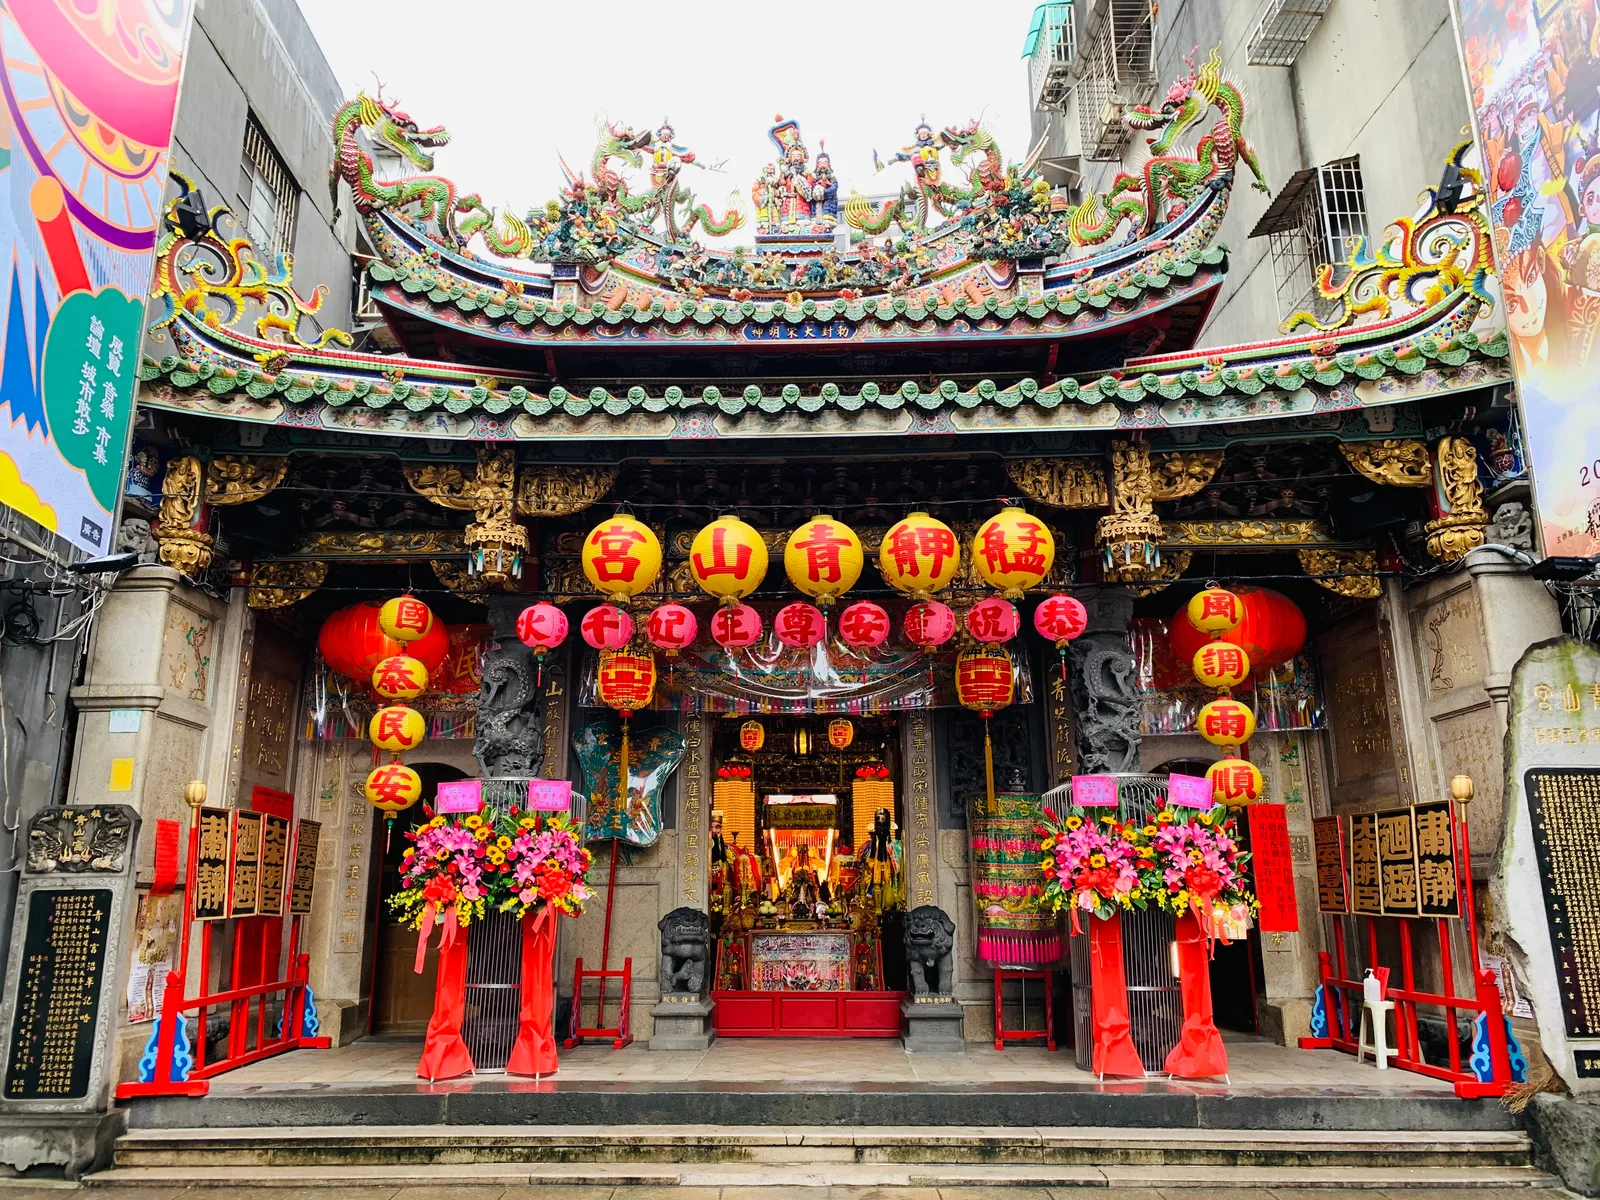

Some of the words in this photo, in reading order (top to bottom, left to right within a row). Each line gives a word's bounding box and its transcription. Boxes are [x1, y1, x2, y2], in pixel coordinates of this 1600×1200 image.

[86, 315, 105, 359] 論壇
[107, 335, 124, 377] 展覽
[72, 361, 96, 435] 城市散步
[100, 382, 118, 420] 音樂
[92, 426, 112, 466] 市集
[82, 519, 100, 542] 廣告
[979, 522, 1047, 576] 艋
[591, 525, 647, 582] 宮
[693, 528, 752, 580] 山
[794, 524, 852, 583] 青
[887, 524, 954, 578] 舺
[582, 608, 619, 644] 千
[716, 609, 749, 643] 王
[780, 605, 817, 644] 尊
[842, 606, 885, 642] 安
[968, 605, 1007, 638] 祝
[1039, 600, 1084, 636] 恭
[1200, 592, 1238, 624] 風
[376, 658, 421, 694] 泰
[1202, 647, 1244, 680] 調
[378, 710, 412, 745] 民
[1205, 705, 1246, 738] 雨
[370, 767, 412, 805] 安
[1212, 765, 1256, 799] 順
[198, 815, 227, 910] 肅靜
[1417, 810, 1455, 907] 肅靜
